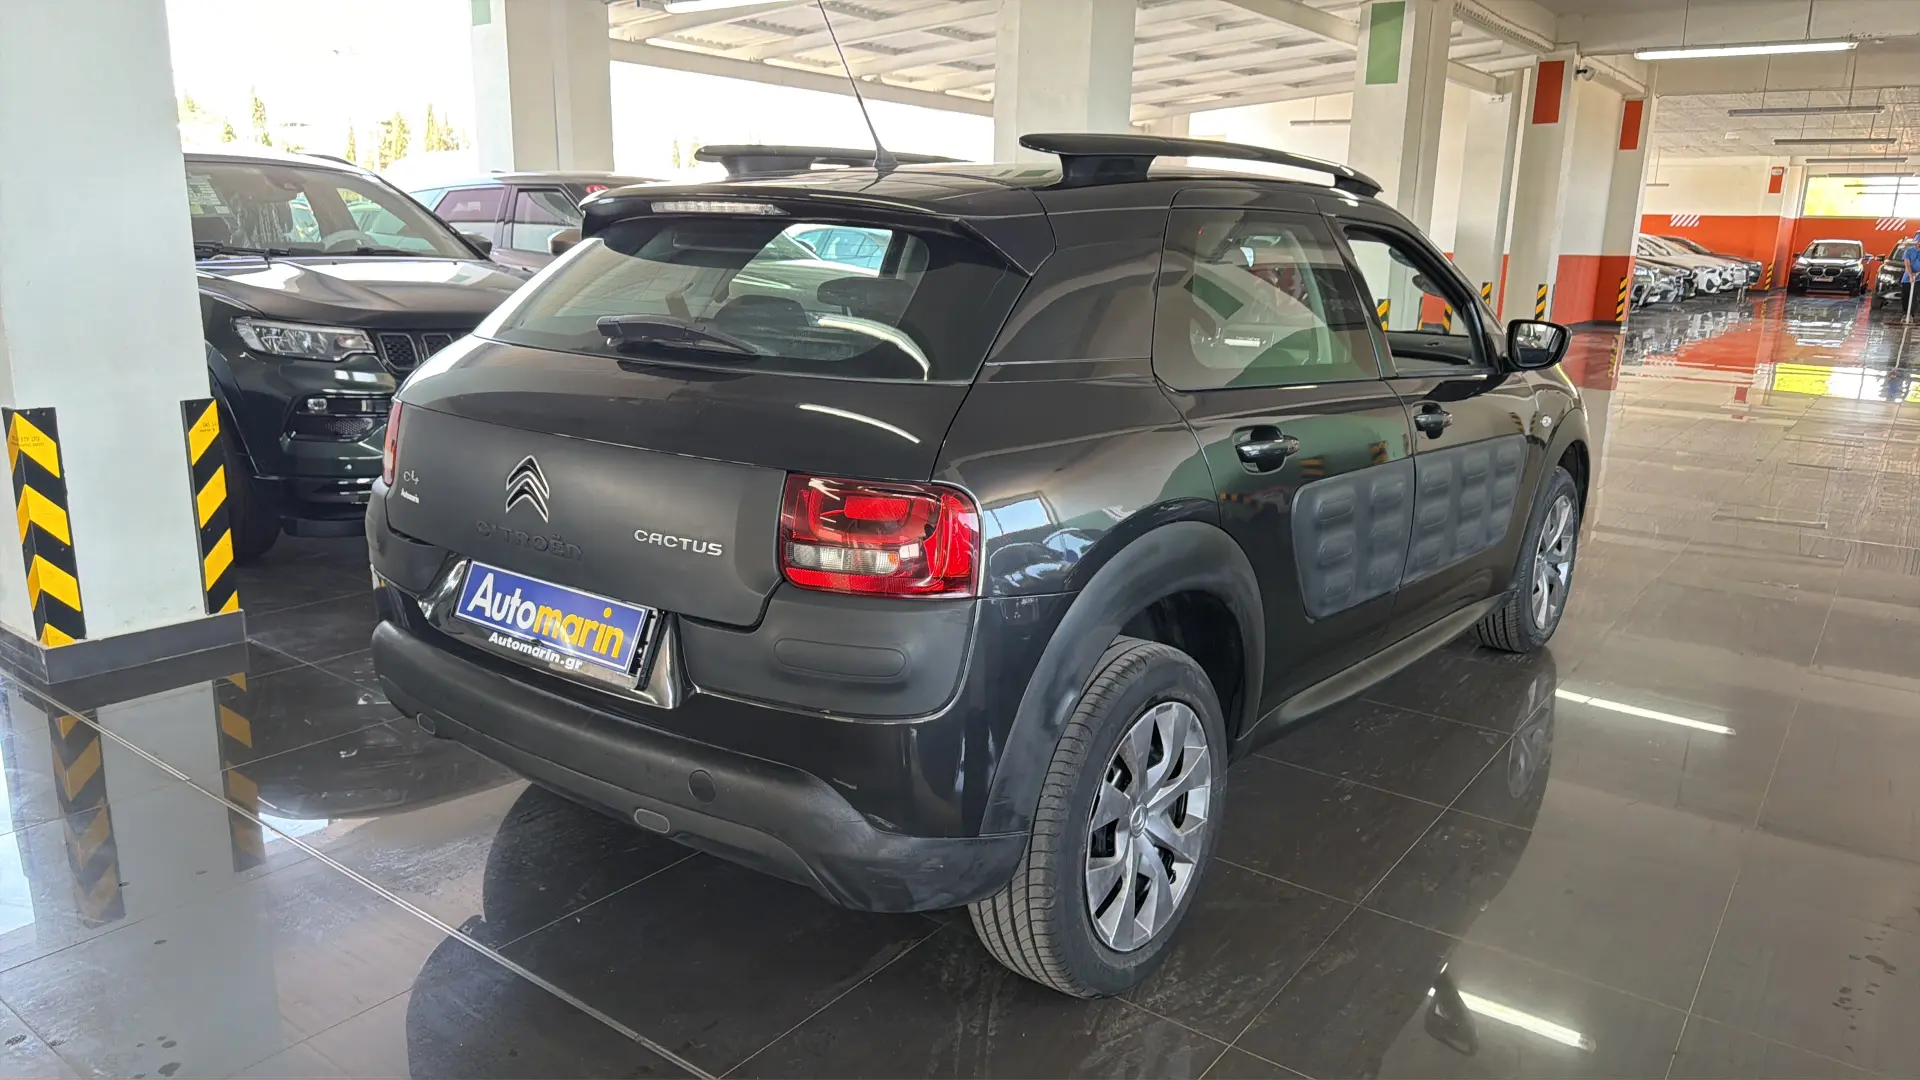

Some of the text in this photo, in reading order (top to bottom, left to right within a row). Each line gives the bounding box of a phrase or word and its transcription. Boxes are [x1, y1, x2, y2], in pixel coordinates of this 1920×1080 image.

[403, 470, 419, 485] C4
[634, 529, 723, 556] CACTUS
[467, 572, 625, 659] Automarin
[488, 632, 583, 670] Automarin.gr
